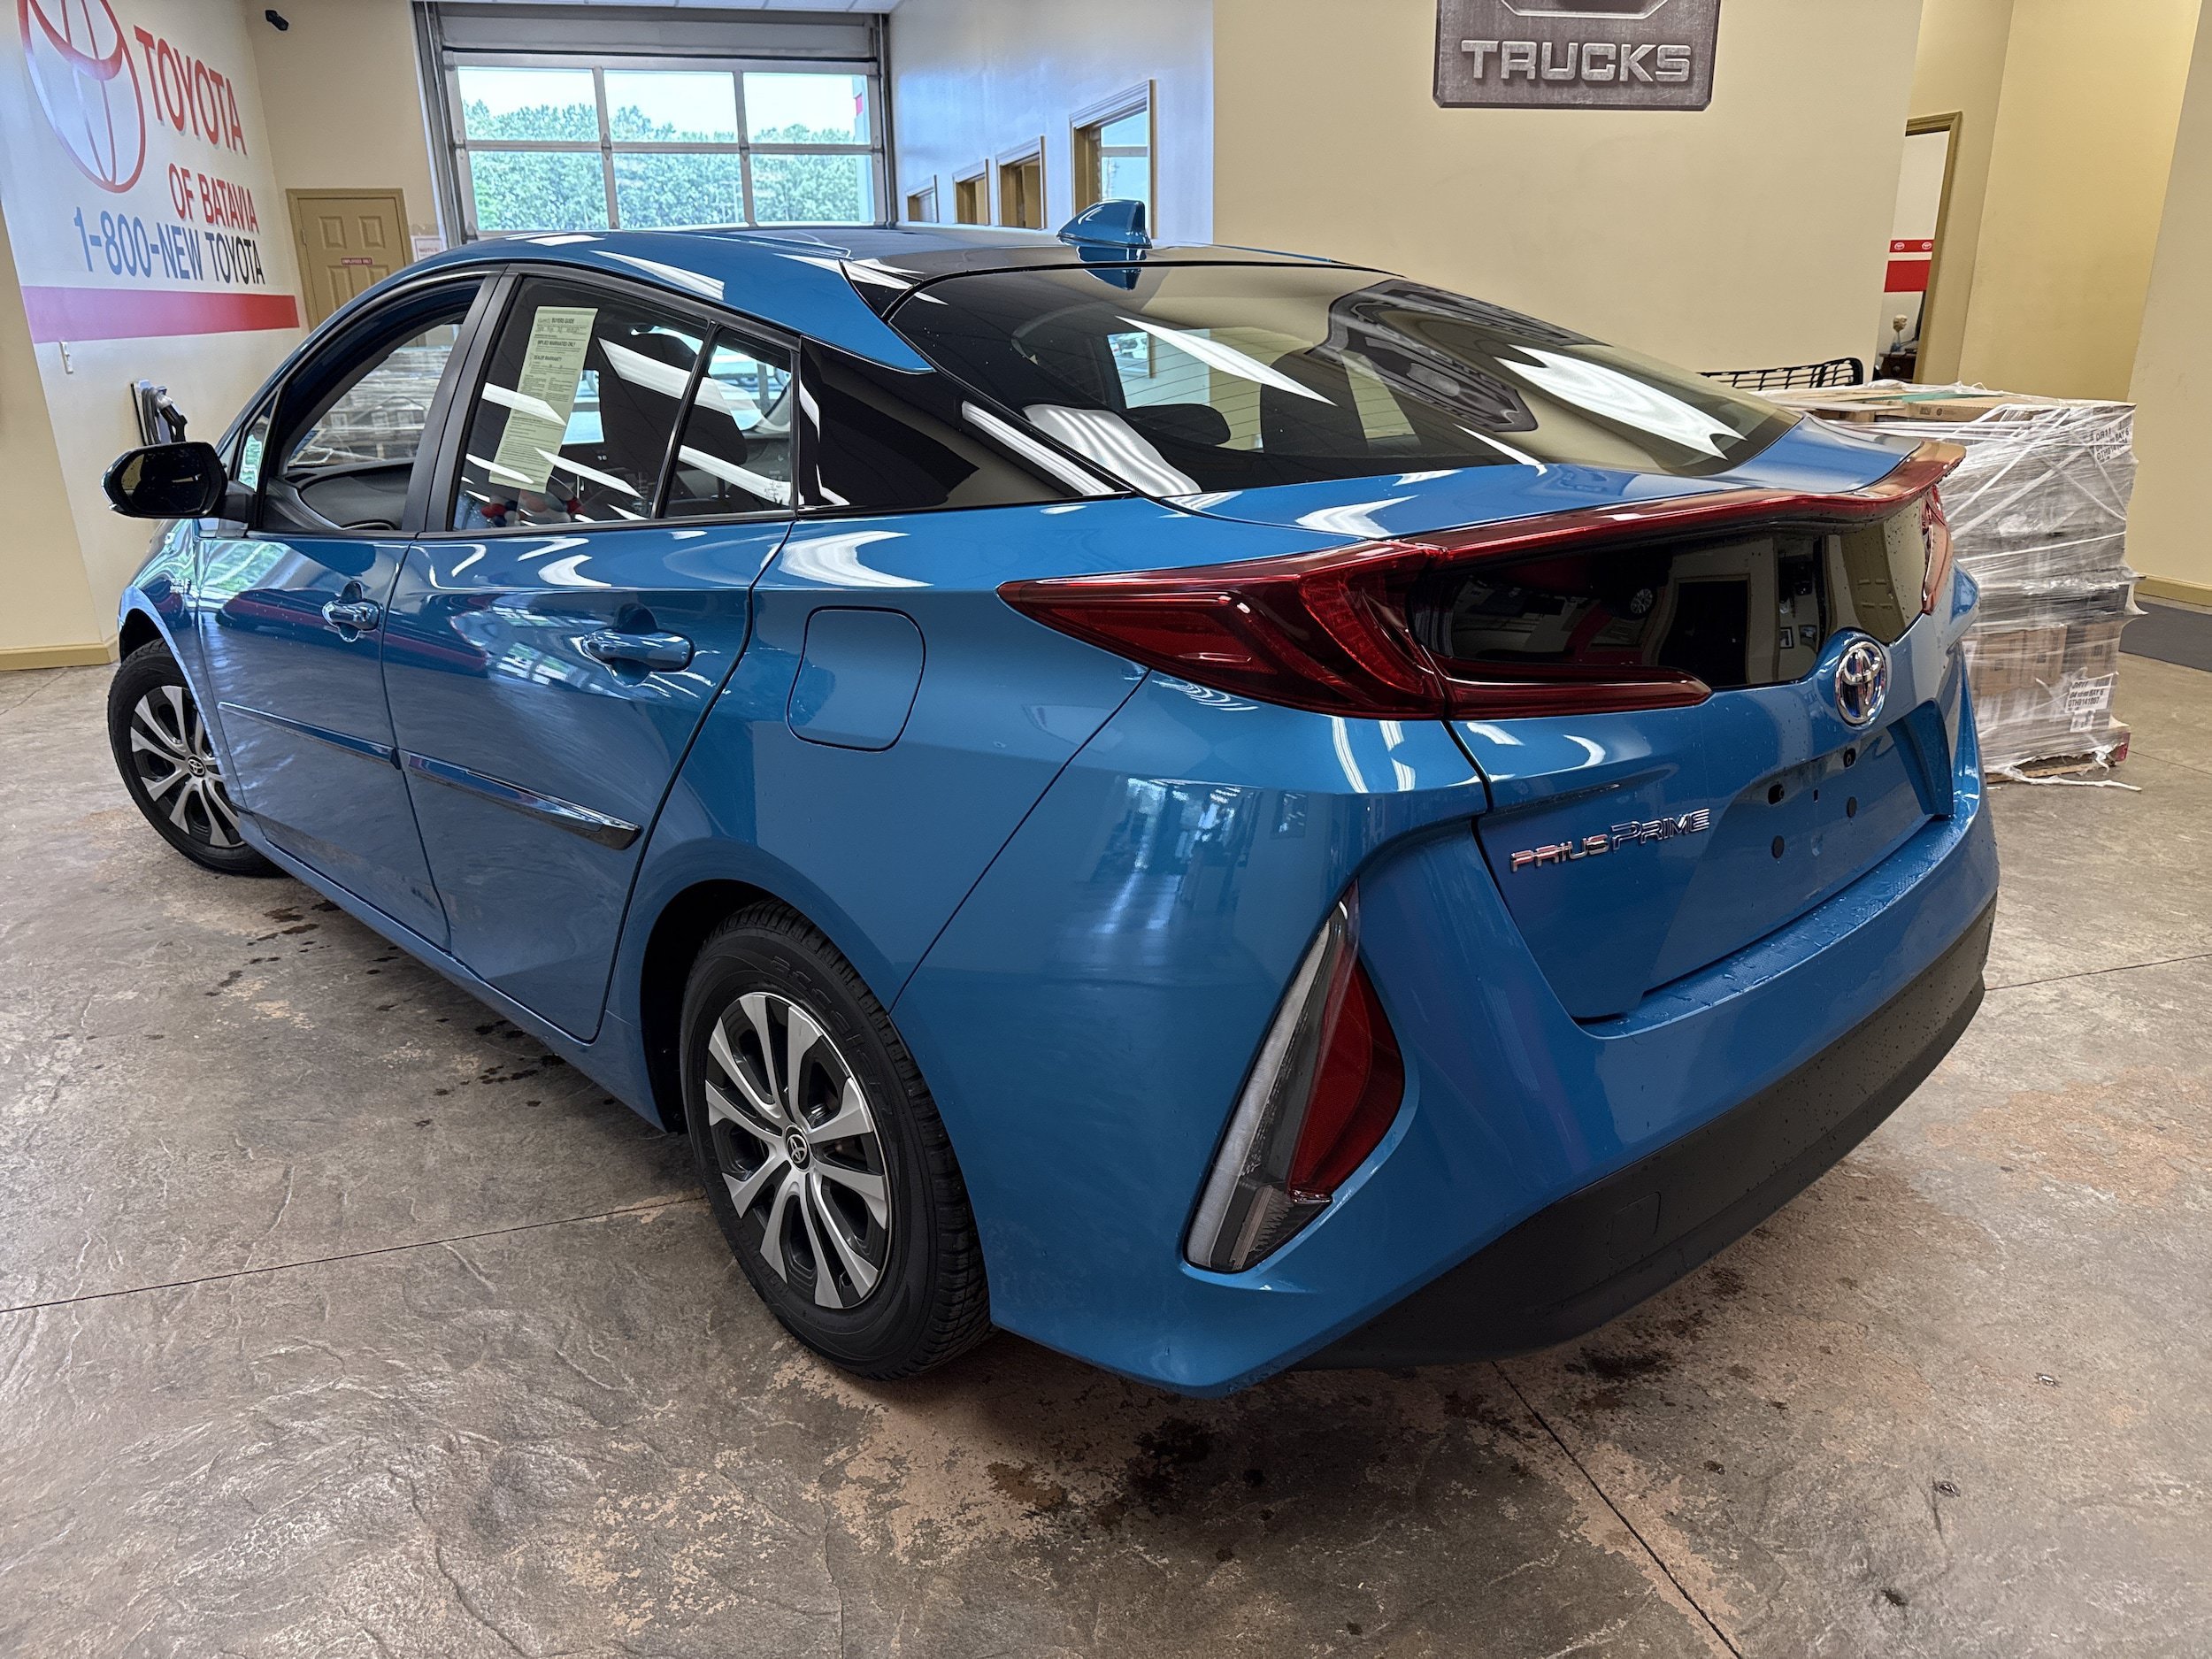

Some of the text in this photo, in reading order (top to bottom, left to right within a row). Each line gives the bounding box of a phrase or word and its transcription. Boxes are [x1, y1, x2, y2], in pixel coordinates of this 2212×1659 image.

[134, 25, 248, 155] TOYOTA
[1461, 40, 1692, 82] TRUCKS
[168, 163, 259, 234] OF BATAVIA
[73, 206, 265, 285] 1-800-NEW TOYOTA
[1510, 808, 1710, 873] PRIUS PRIME
